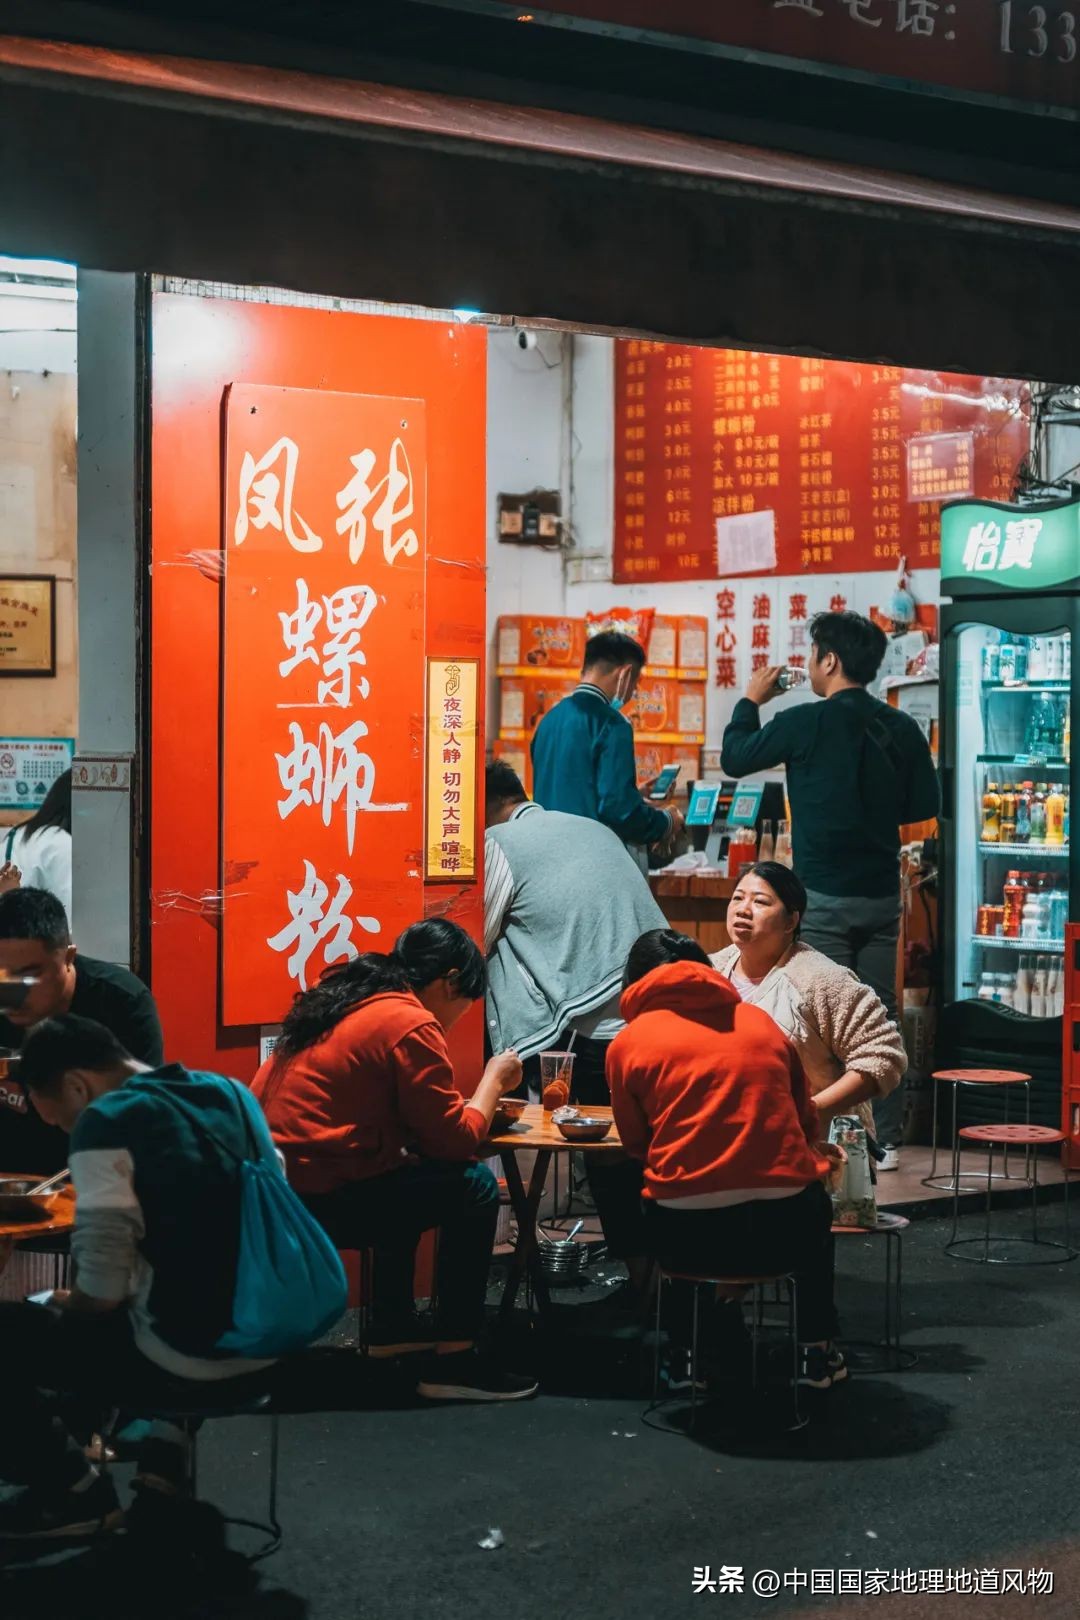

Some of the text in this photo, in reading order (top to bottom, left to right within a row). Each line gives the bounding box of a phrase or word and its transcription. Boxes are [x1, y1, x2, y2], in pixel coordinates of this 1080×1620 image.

[716, 587, 736, 689] 空心菜
[441, 697, 462, 873] 夜深人静 切勿大声喧哗
